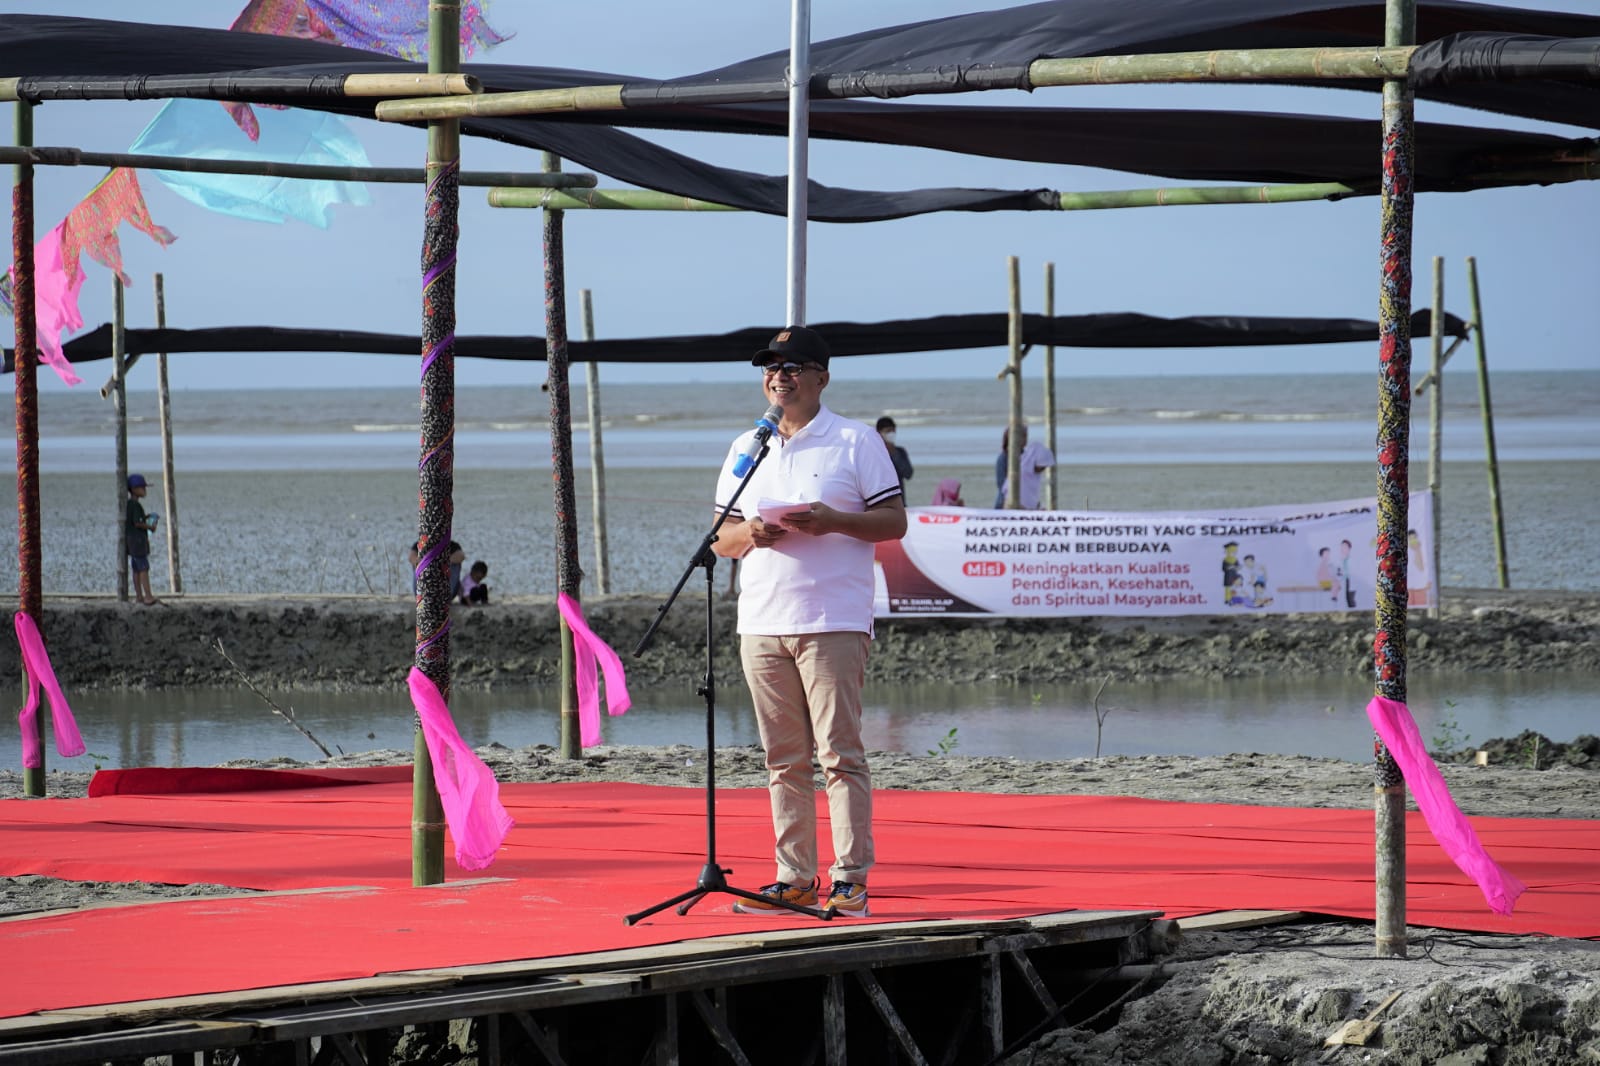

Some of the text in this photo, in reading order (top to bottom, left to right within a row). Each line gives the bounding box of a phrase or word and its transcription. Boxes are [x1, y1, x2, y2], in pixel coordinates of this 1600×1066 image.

[965, 525, 1296, 537] MASYARAKAT INDUSTRI YANG SEJAHTERA,
[965, 542, 1172, 553] MANDIRI DAN BERBUDAYA
[967, 563, 1001, 575] Misi
[1012, 562, 1191, 577] Meningkatkan Kualitas
[1012, 577, 1194, 591] Pendidikan, Kesehatan,
[1012, 593, 1208, 608] dan Spiritual Masyarakat.
